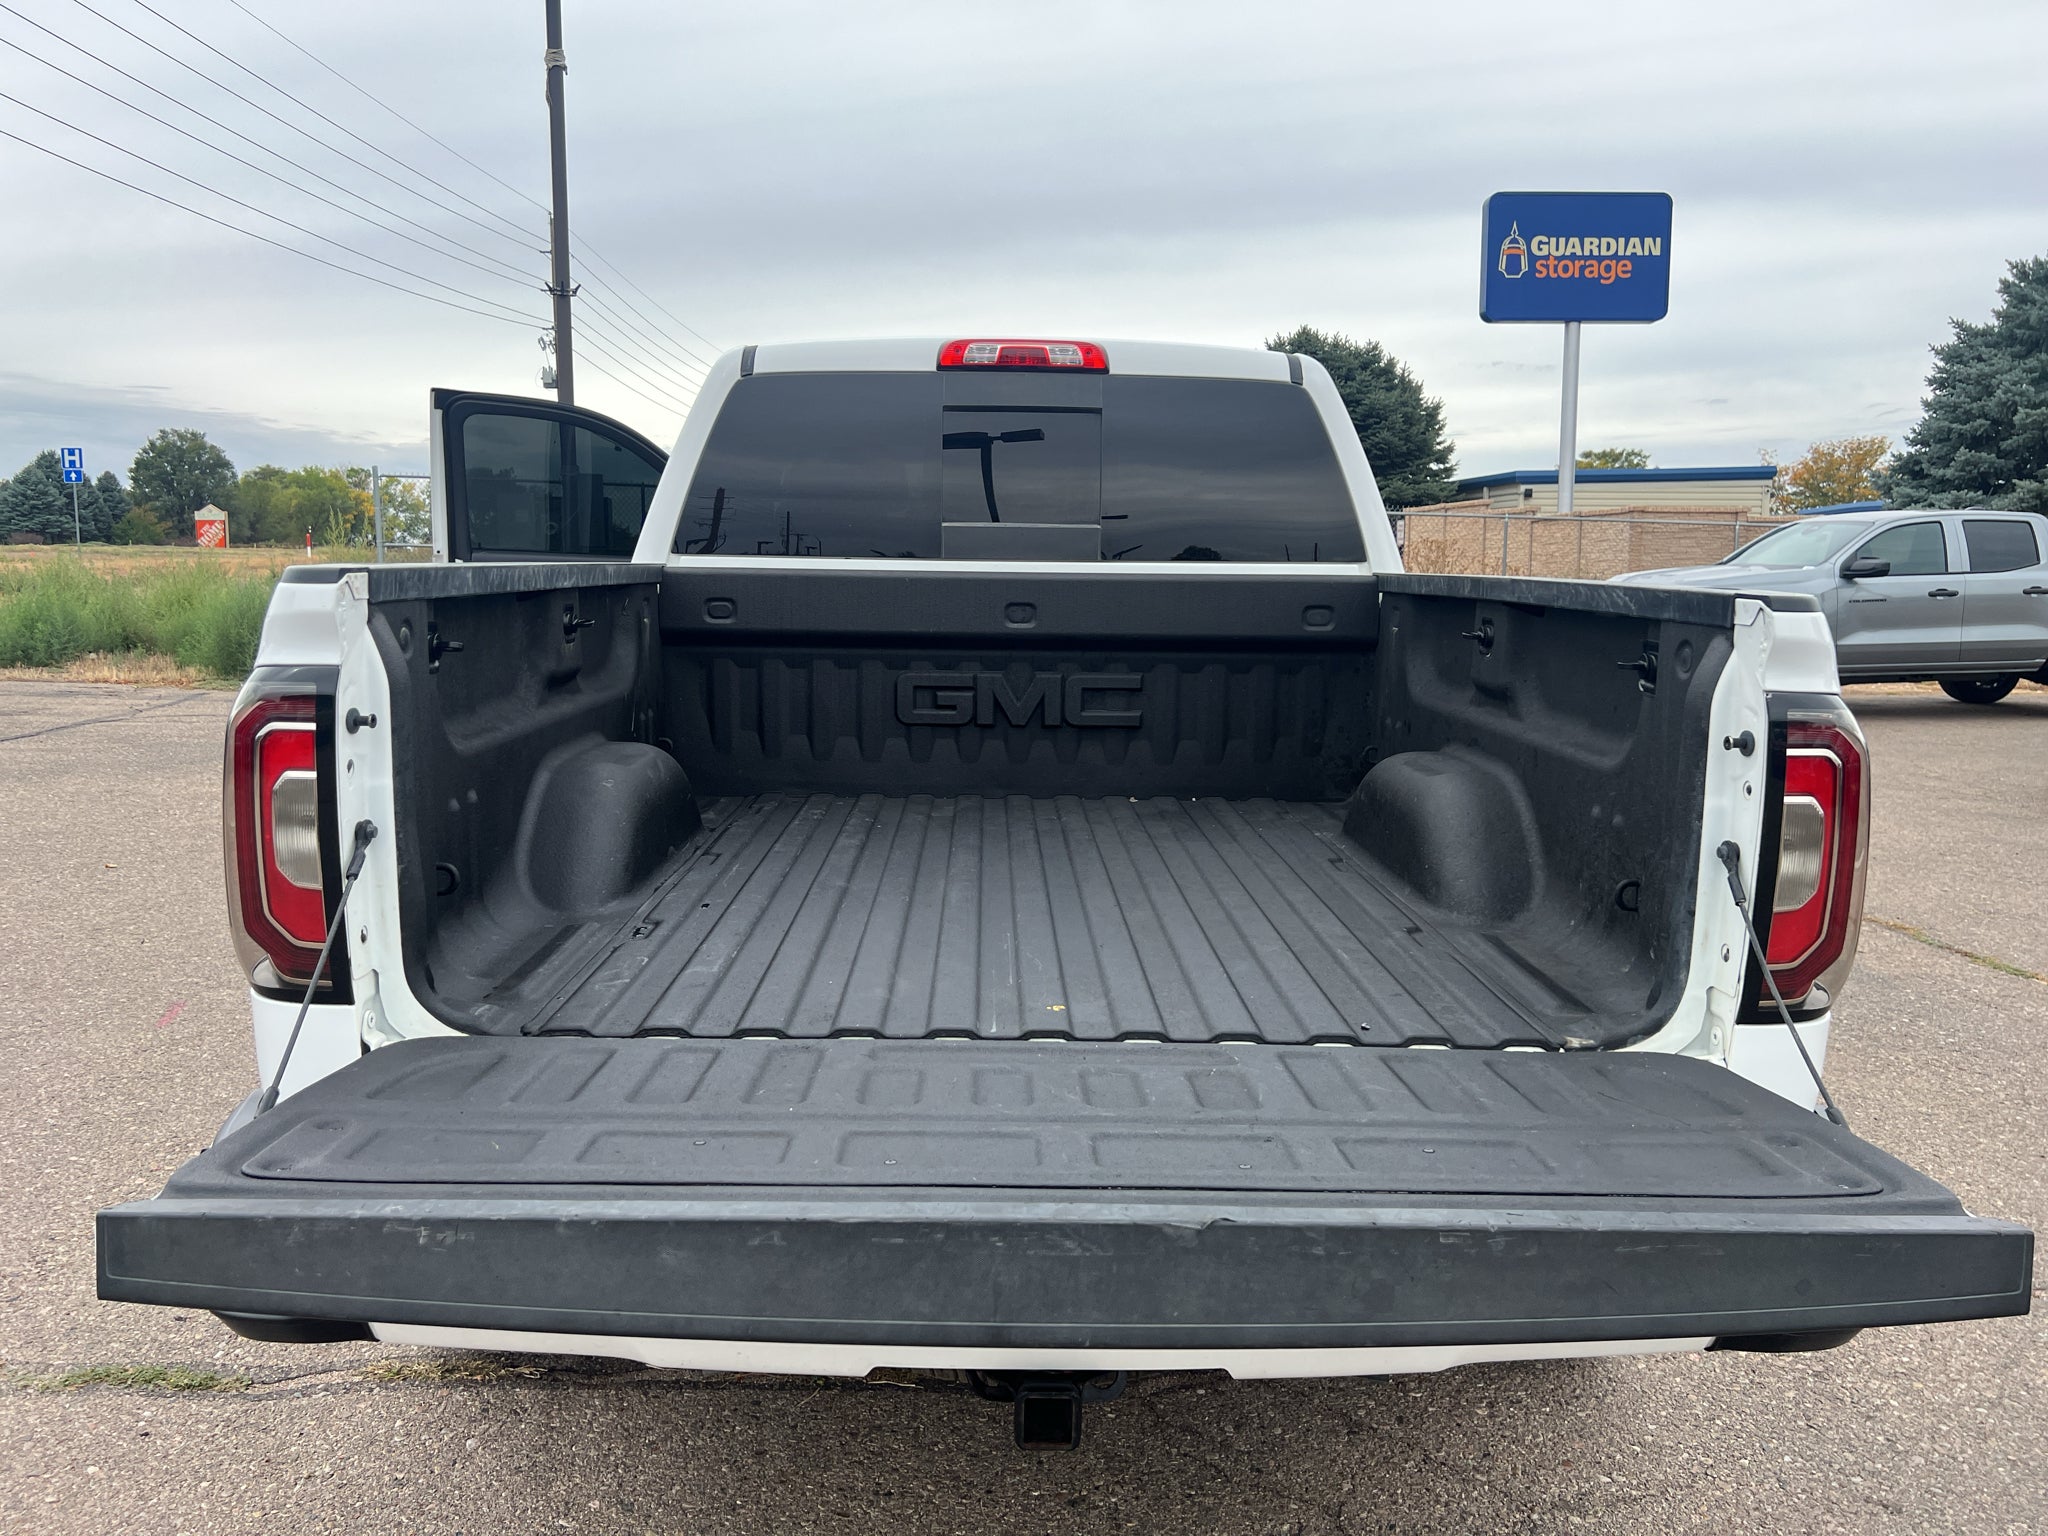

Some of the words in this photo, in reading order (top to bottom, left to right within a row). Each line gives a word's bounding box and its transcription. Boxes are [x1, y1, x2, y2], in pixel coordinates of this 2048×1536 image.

[1530, 235, 1661, 257] GUARDIAN
[1535, 256, 1632, 285] storage
[63, 449, 80, 468] H
[896, 671, 1143, 727] GMC
